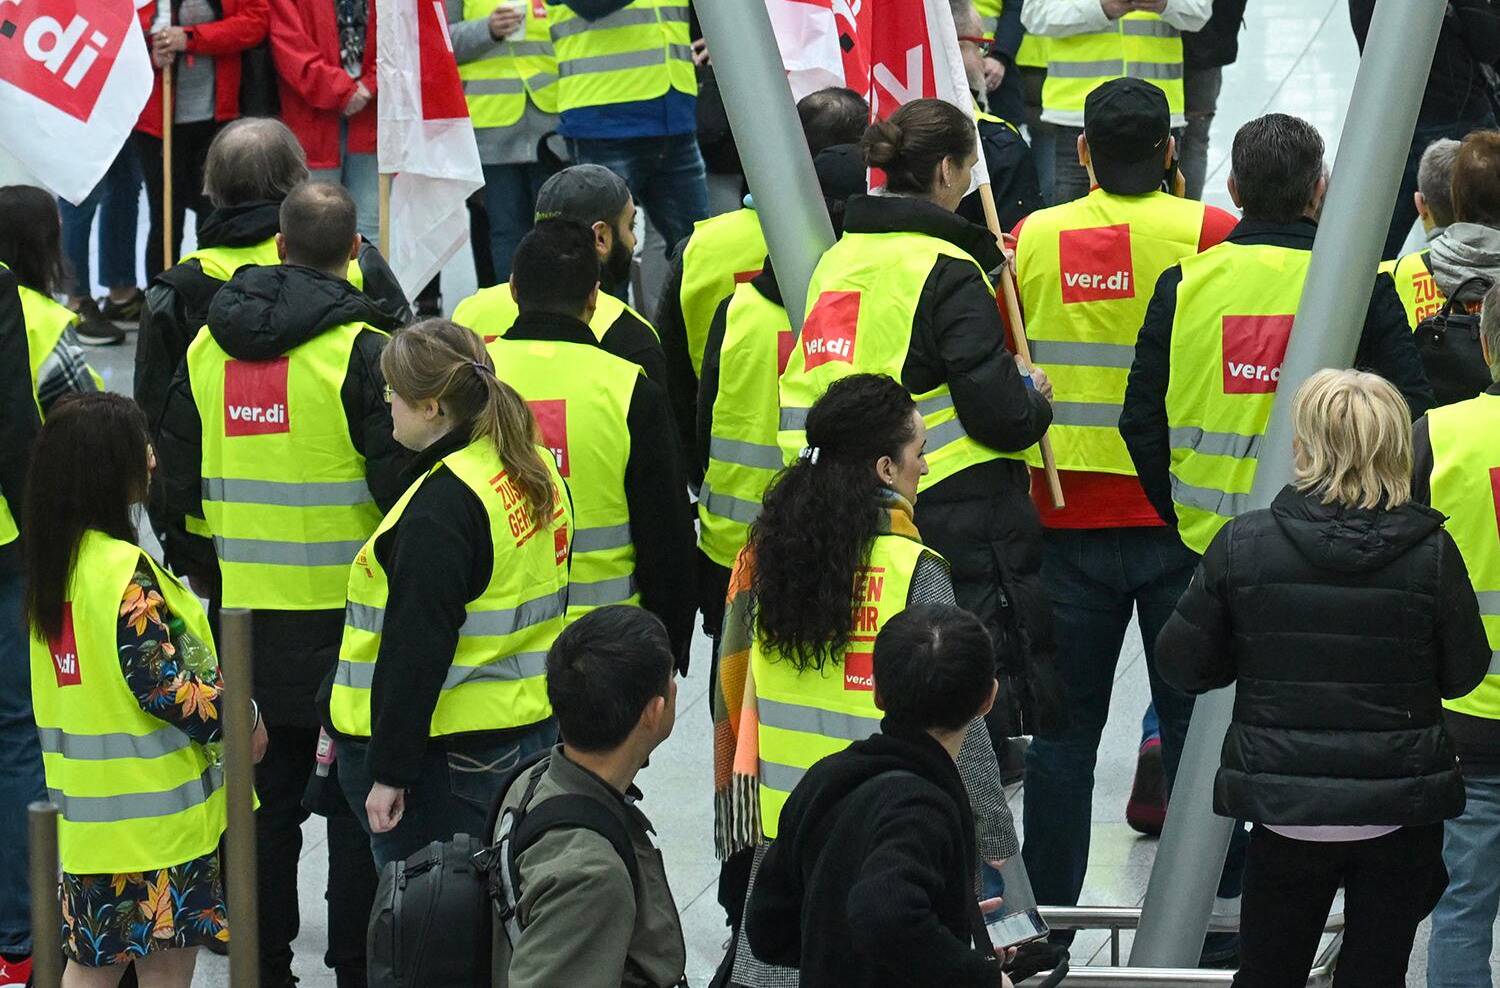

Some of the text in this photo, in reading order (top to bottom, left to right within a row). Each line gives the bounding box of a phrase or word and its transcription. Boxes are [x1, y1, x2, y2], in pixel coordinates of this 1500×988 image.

[1064, 271, 1129, 291] ver.di
[805, 337, 851, 358] ver.di
[228, 404, 285, 424] ver.di
